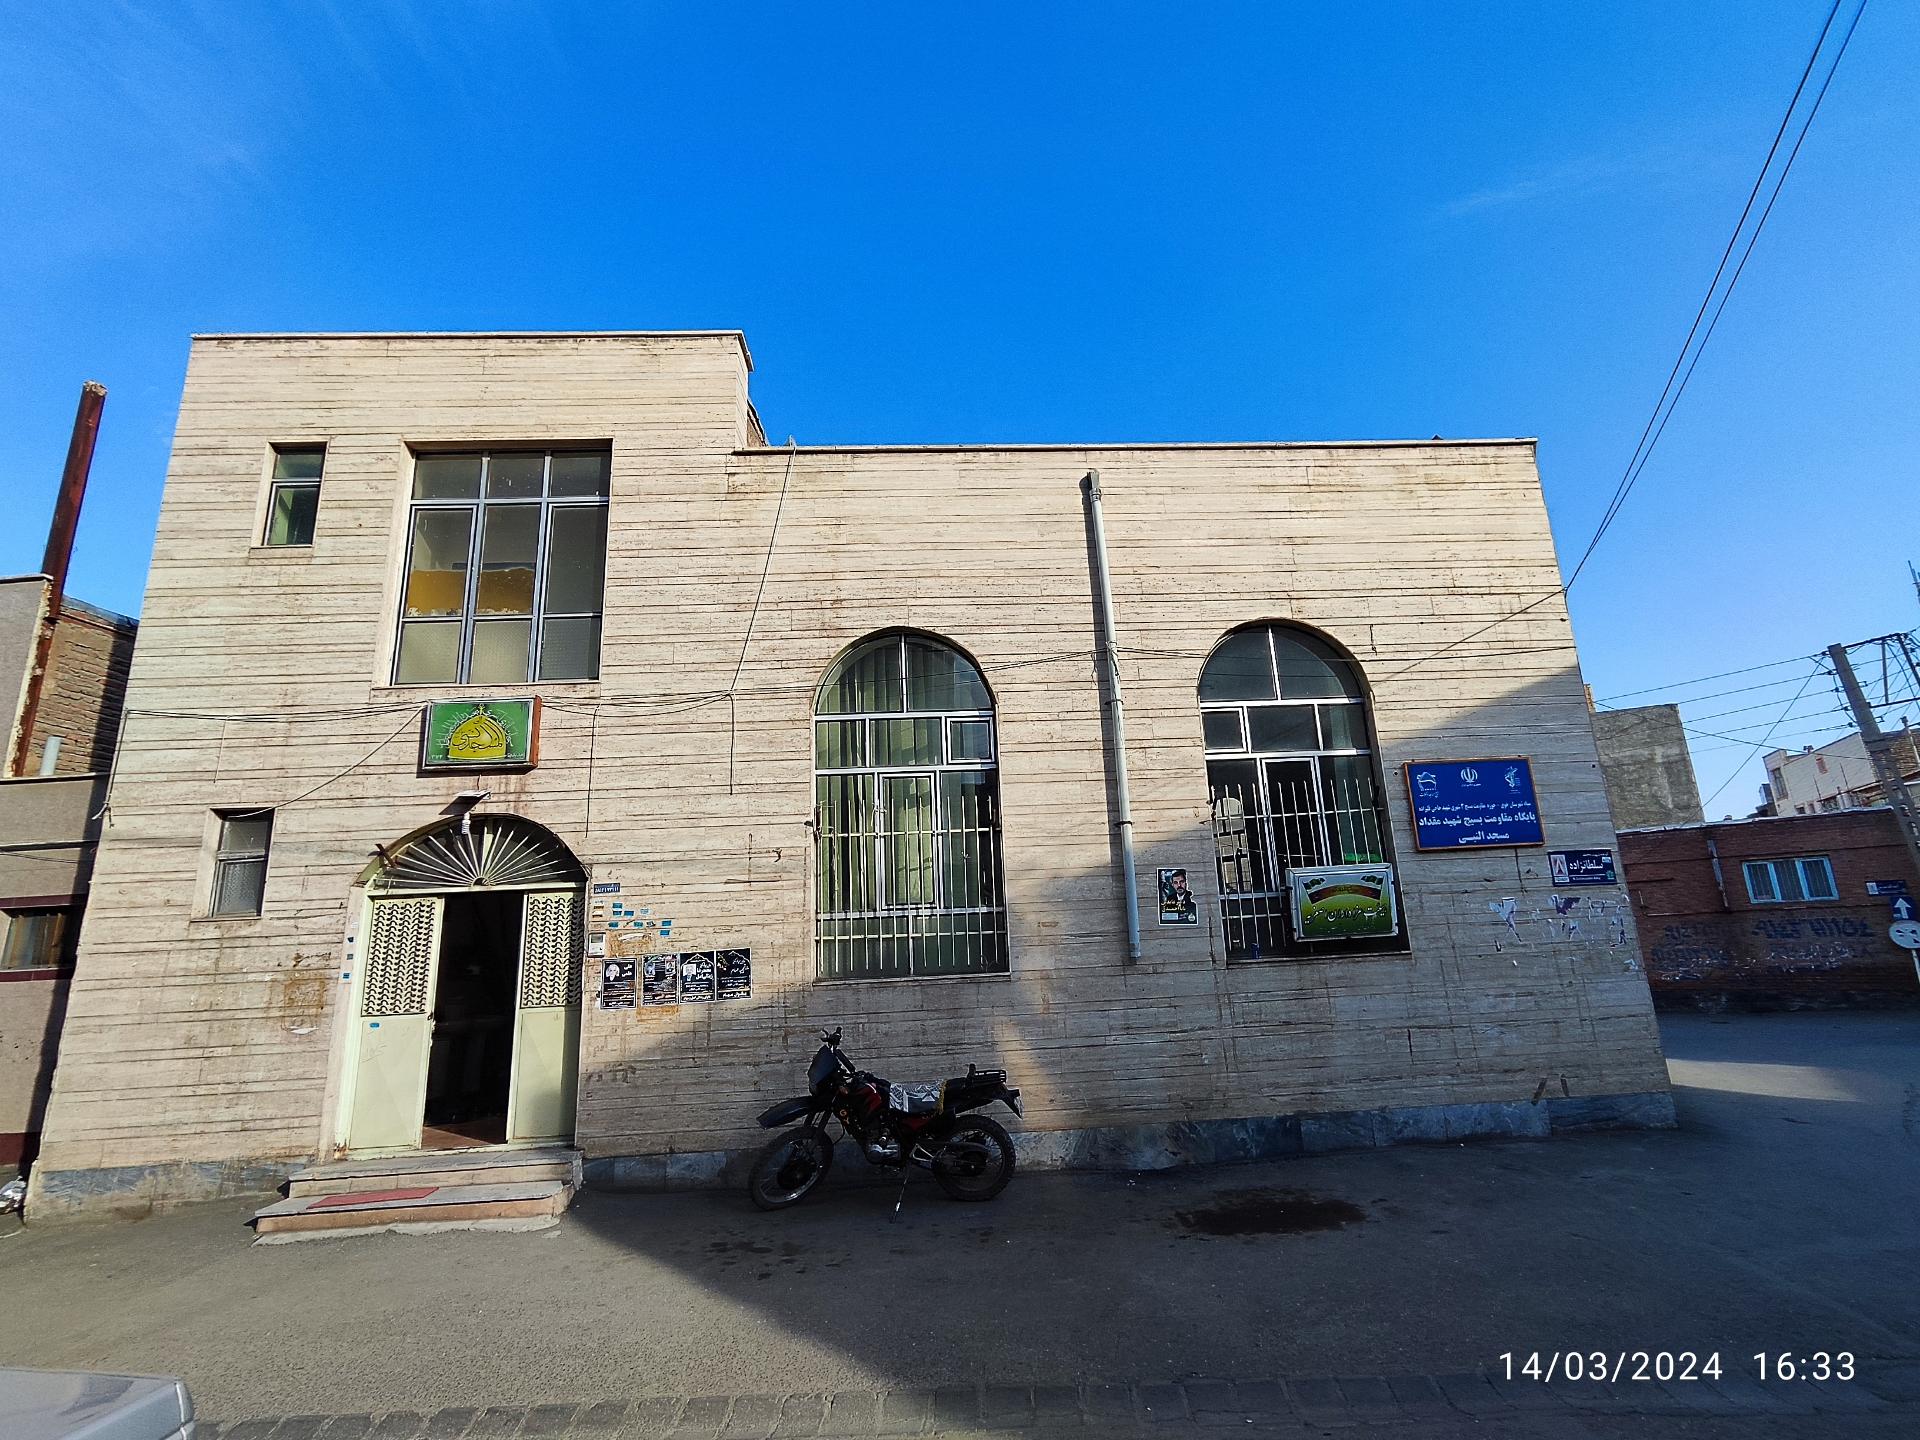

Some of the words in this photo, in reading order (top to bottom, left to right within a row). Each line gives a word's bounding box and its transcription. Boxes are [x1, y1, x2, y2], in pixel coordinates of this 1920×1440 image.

[1418, 817, 1441, 826] مقداد
[1443, 815, 1462, 827] شهید
[1463, 816, 1483, 827] بسیج
[1484, 813, 1512, 825] مقاومت
[1514, 812, 1537, 823] پایگاه
[1458, 830, 1485, 844] النبی
[1486, 831, 1510, 842] مسجد
